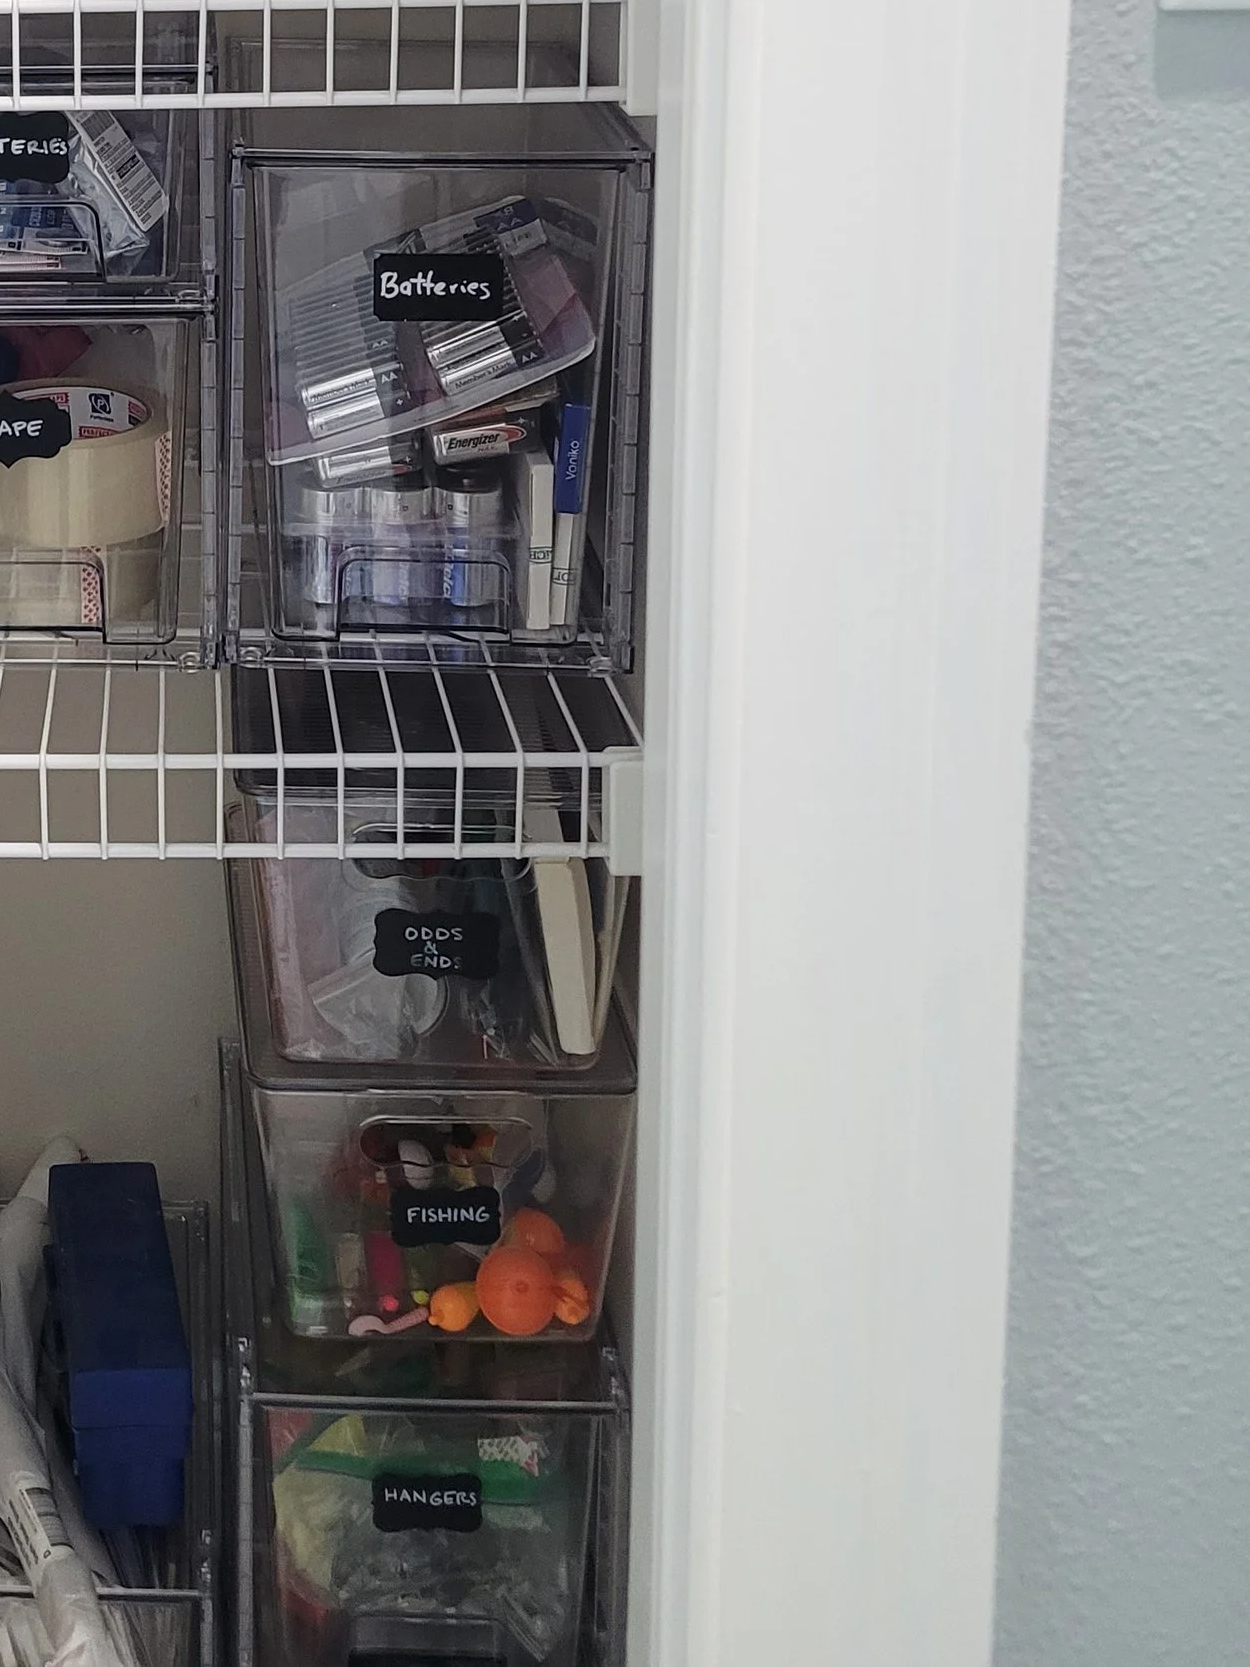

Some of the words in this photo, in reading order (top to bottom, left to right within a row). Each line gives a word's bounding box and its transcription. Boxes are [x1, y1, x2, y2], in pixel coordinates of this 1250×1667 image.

[379, 269, 492, 300] Batteries
[521, 351, 538, 363] AA
[381, 371, 398, 384] AA
[447, 433, 500, 450] Energizer
[565, 440, 580, 481] Voniko
[405, 926, 463, 941] ODDS
[424, 940, 439, 954] &
[407, 1205, 491, 1223] FISHING
[384, 1487, 477, 1507] HANGERS
